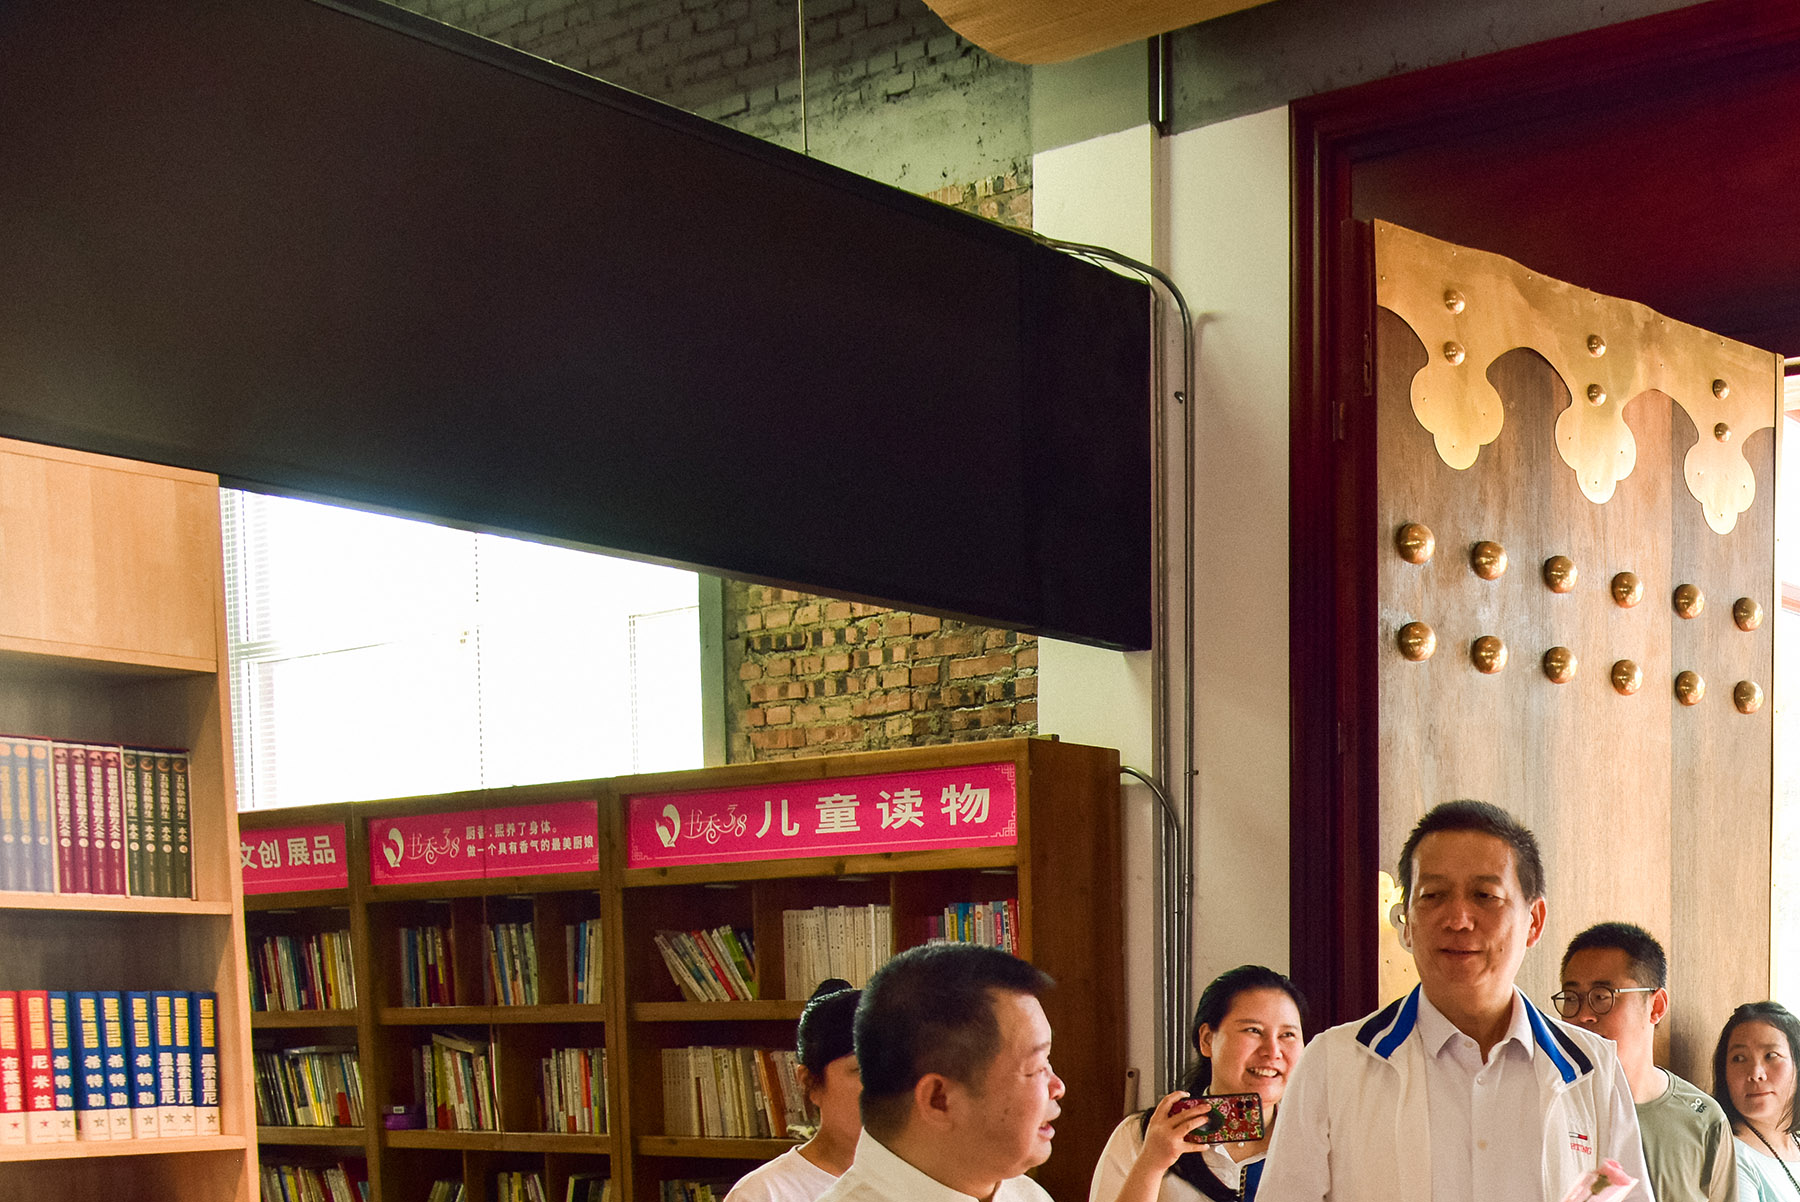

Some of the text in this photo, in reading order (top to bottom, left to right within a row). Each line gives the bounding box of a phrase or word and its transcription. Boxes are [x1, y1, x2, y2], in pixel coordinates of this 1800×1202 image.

[756, 783, 990, 838] 儿童读物
[466, 835, 594, 857] 做一个具有香气的最美厨娘
[31, 1055, 52, 1109] 尼米兹
[53, 1055, 73, 1108] 希特勒
[84, 1055, 106, 1107] 希特勒
[107, 1054, 128, 1106] 希特勒
[135, 1054, 156, 1105] 希特勒
[158, 1052, 176, 1104] 墨索里尼
[176, 1053, 193, 1104] 墨索里尼
[201, 1054, 218, 1105] 墨索里尼
